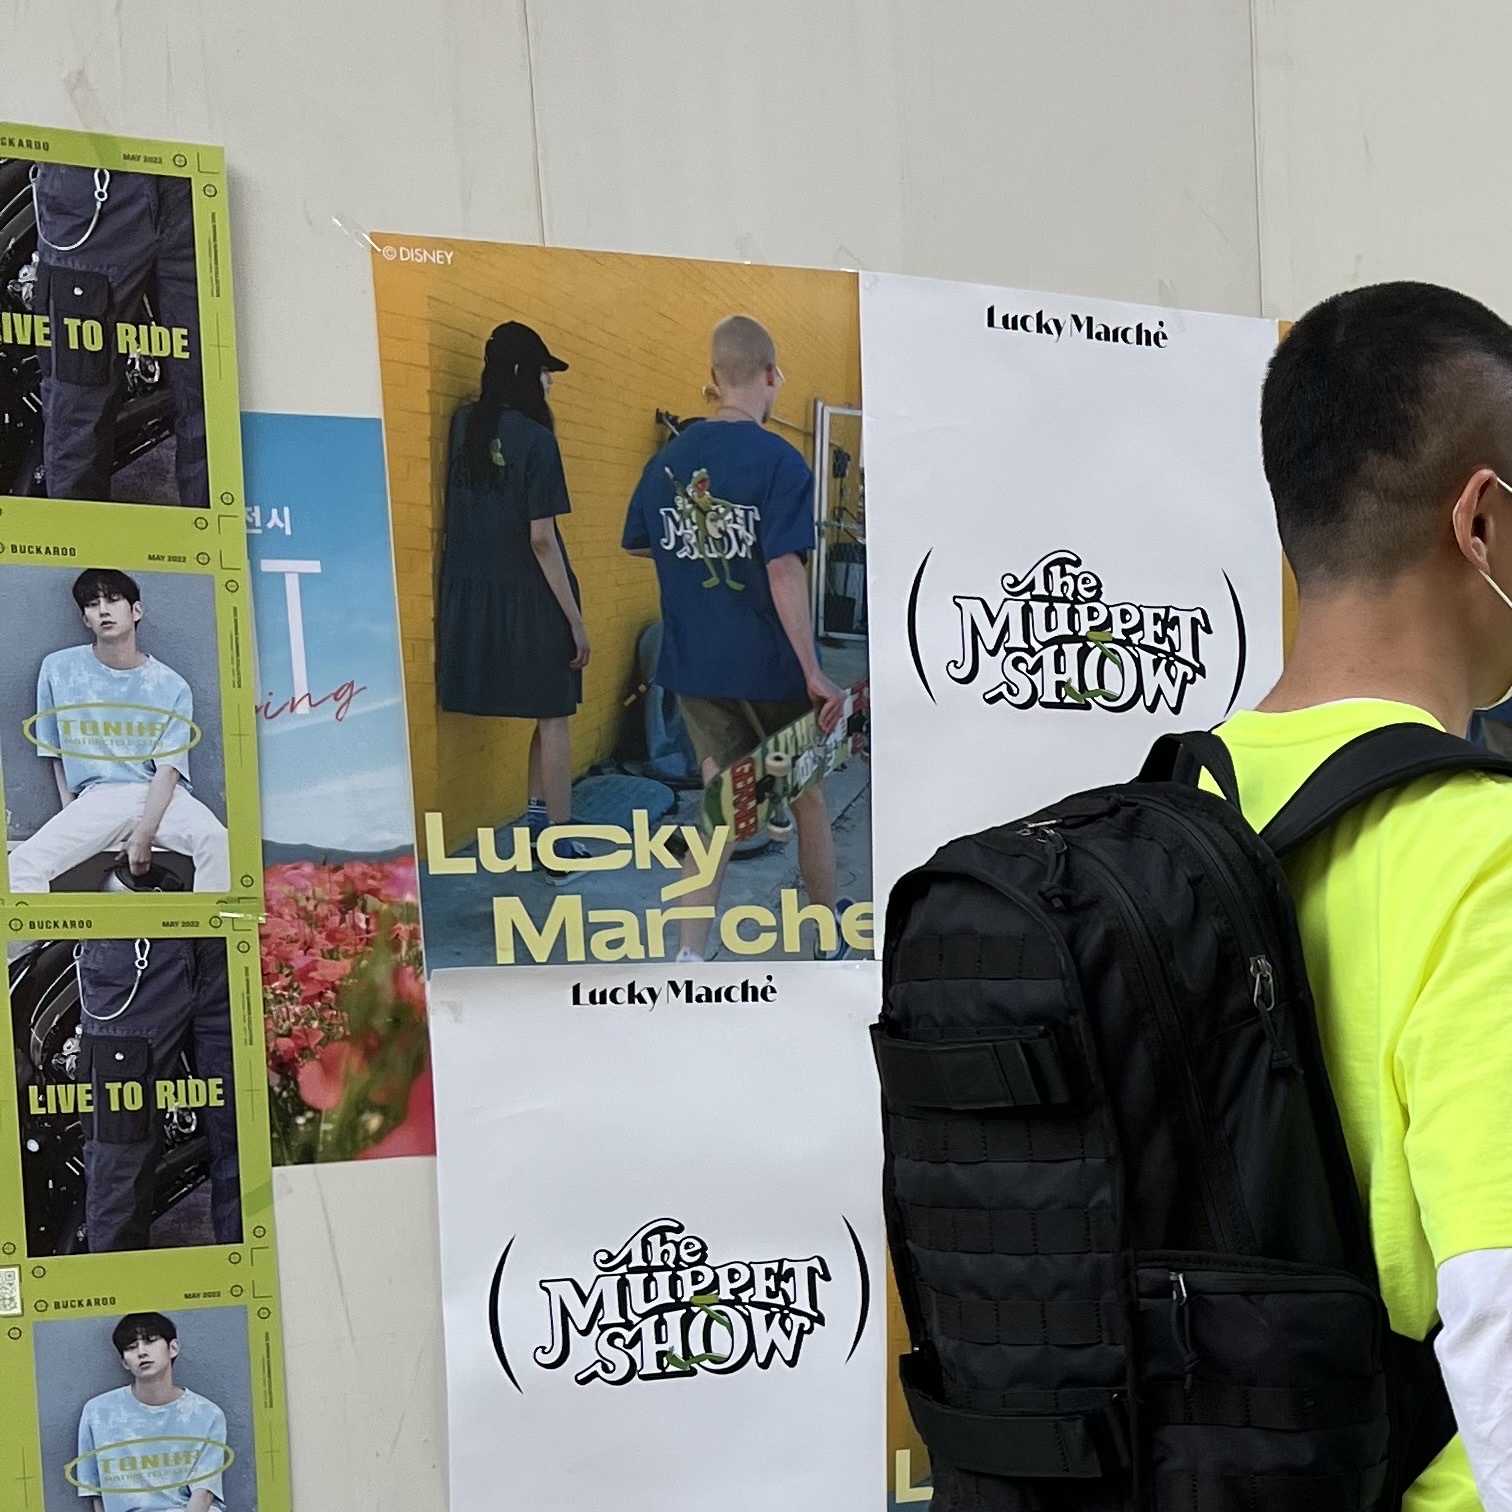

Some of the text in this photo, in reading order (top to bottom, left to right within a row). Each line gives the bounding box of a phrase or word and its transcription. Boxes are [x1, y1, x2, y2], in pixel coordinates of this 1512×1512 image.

[0, 137, 50, 152] CKAROO
[0, 311, 190, 359] IVE TO RIDE
[985, 305, 1066, 343] Lucky
[1001, 549, 1102, 602] The
[946, 594, 1213, 684] MUPPET
[983, 642, 1206, 715] SHOW
[425, 809, 730, 902] Lucky
[493, 888, 874, 964] Marche
[572, 979, 664, 1012] Lucky
[28, 1077, 226, 1115] LIVE TO RIDE
[593, 1218, 708, 1273] The
[533, 1255, 832, 1370] MUPPET
[575, 1304, 814, 1386] SHOW
